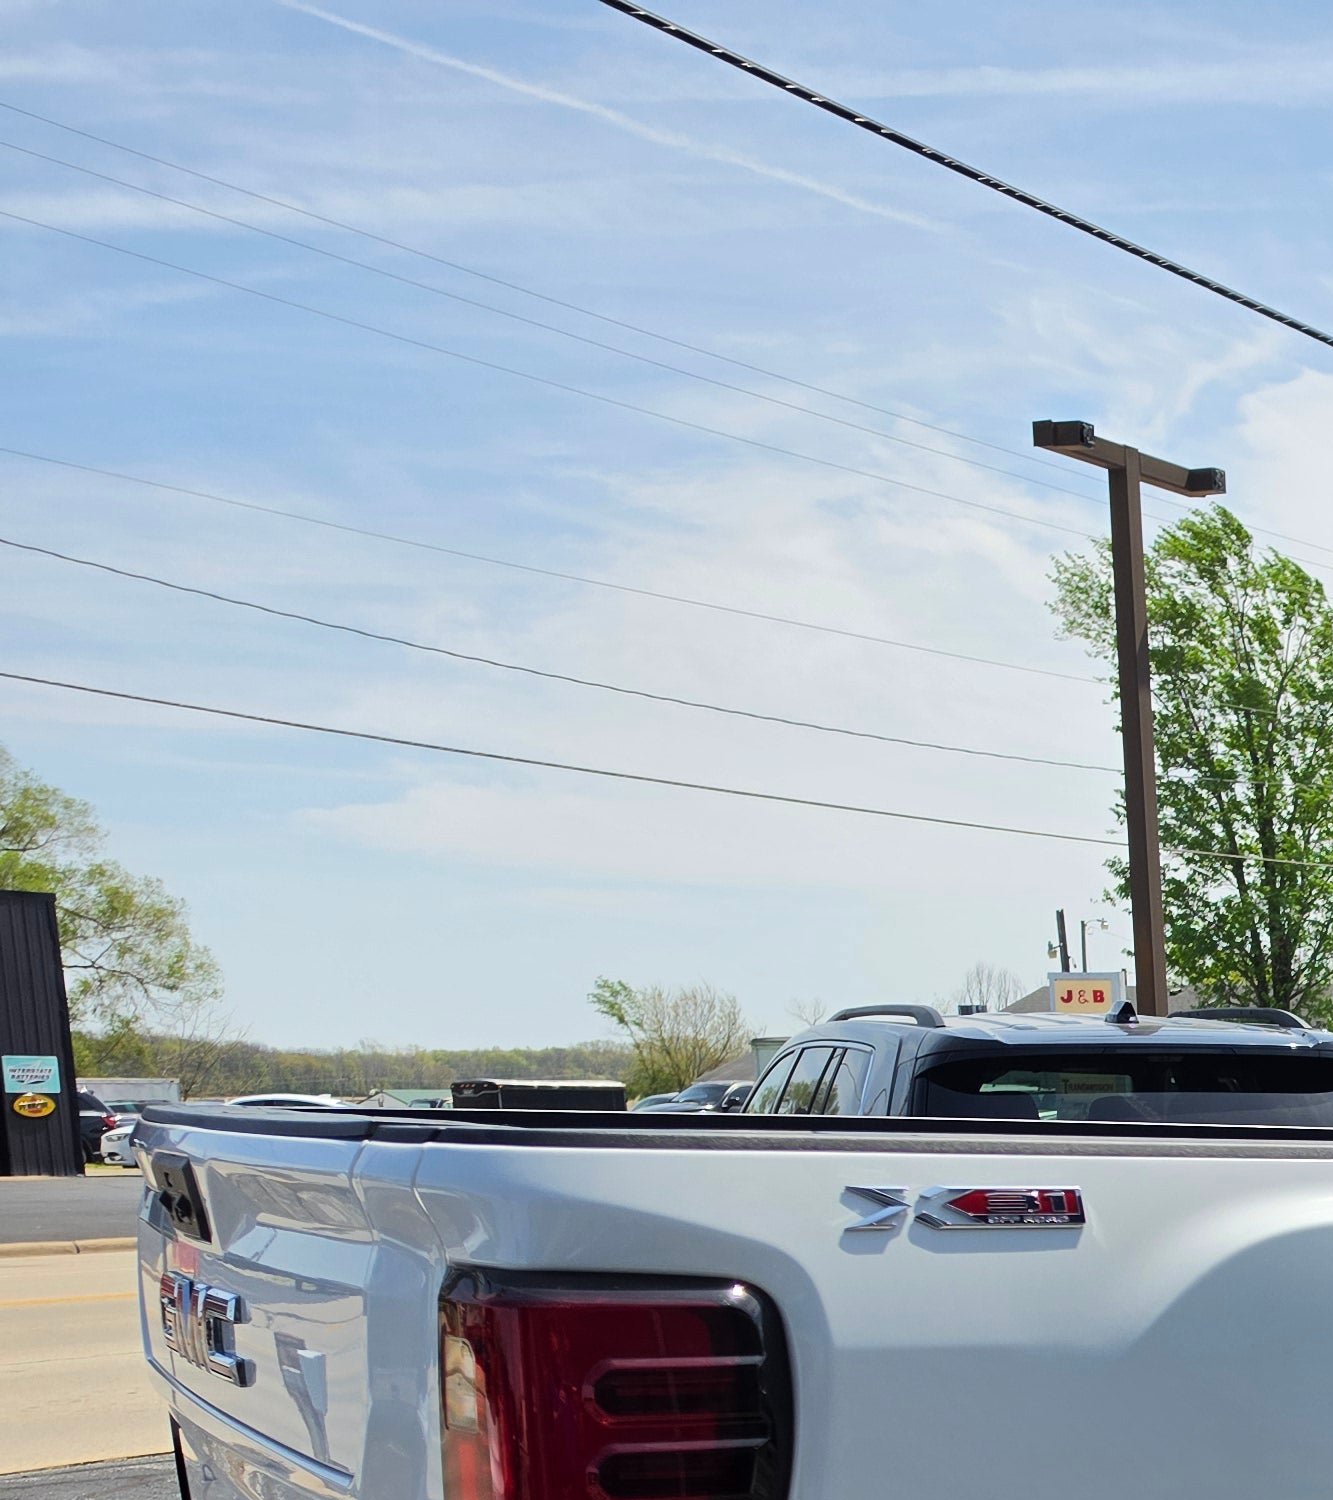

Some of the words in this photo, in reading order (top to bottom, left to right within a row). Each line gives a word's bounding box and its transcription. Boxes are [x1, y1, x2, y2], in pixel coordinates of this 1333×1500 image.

[1060, 989, 1073, 1004] J
[1078, 989, 1089, 1004] &
[1092, 989, 1105, 1003] B
